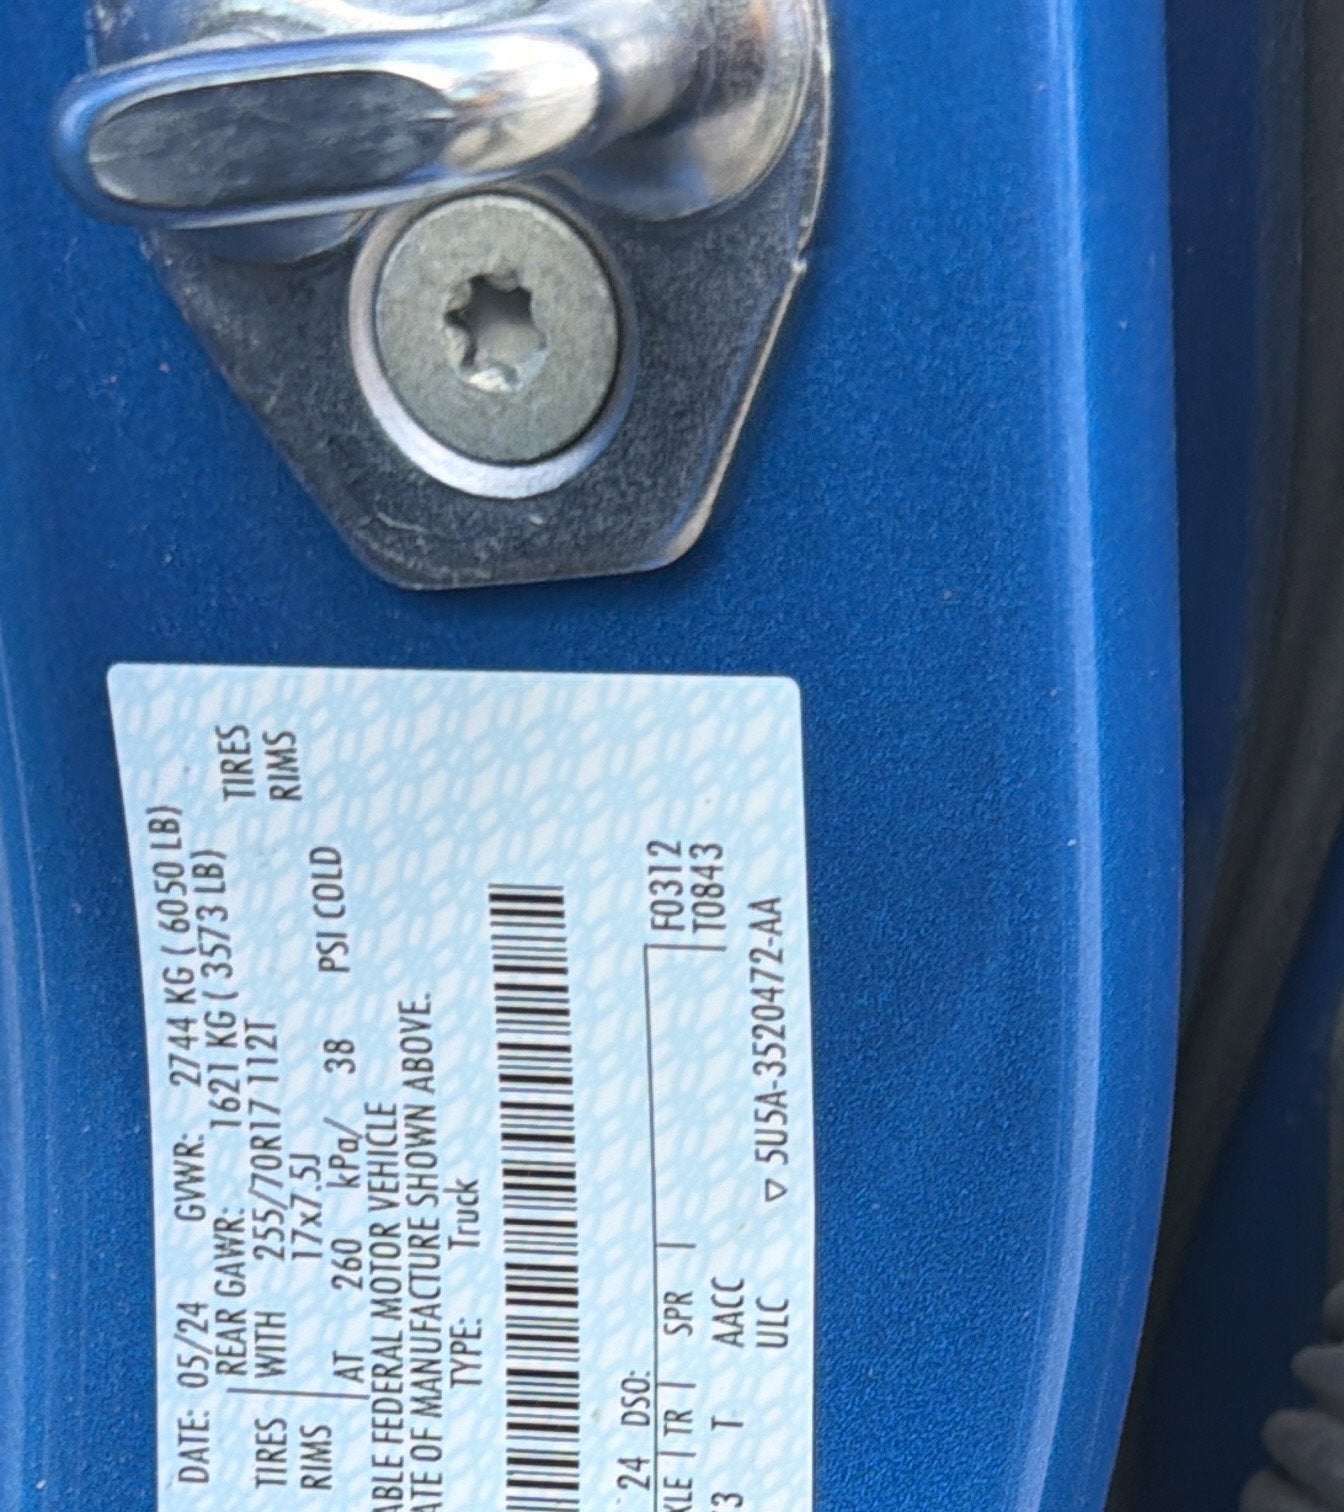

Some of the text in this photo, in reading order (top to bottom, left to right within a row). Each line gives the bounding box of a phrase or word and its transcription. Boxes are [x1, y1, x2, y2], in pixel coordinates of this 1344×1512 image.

[215, 724, 257, 802] TIRES
[262, 730, 303, 802] RIMS
[646, 839, 686, 932] F0312
[689, 843, 726, 935] T0843
[146, 805, 207, 1221] GVWR: 2744 KG ( 6050 LB)
[397, 992, 435, 1095] ABOVE.
[747, 896, 789, 1166] 5U5A-3520472-AA
[190, 849, 247, 1376] REAR GAWR: 1621 KG ( 3573 LB)
[308, 845, 365, 1384] AT 260 kPa/ 38 PSI COLD
[364, 1101, 400, 1212] VEHICLE
[403, 1104, 439, 1207] SHOWN
[243, 1017, 288, 1378] WITH 255/70R17 112T
[289, 1152, 323, 1261] 17x7.5J
[369, 1222, 403, 1321] MOTOR
[409, 1217, 443, 1418] MANUFACTURE
[443, 1179, 482, 1388] TYPE: Truck
[664, 1290, 693, 1336] SPR
[710, 1276, 744, 1348] AACC
[756, 1296, 789, 1349] ULC
[173, 1301, 213, 1483] DATE: 05/24
[370, 1331, 404, 1444] FEDERAL
[620, 1370, 651, 1427] DSO:
[663, 1409, 694, 1436] TR
[711, 1415, 744, 1431] T
[254, 1417, 288, 1489] TIRES
[299, 1424, 332, 1491] RIMS
[410, 1427, 443, 1462] OF
[617, 1456, 651, 1491] 24
